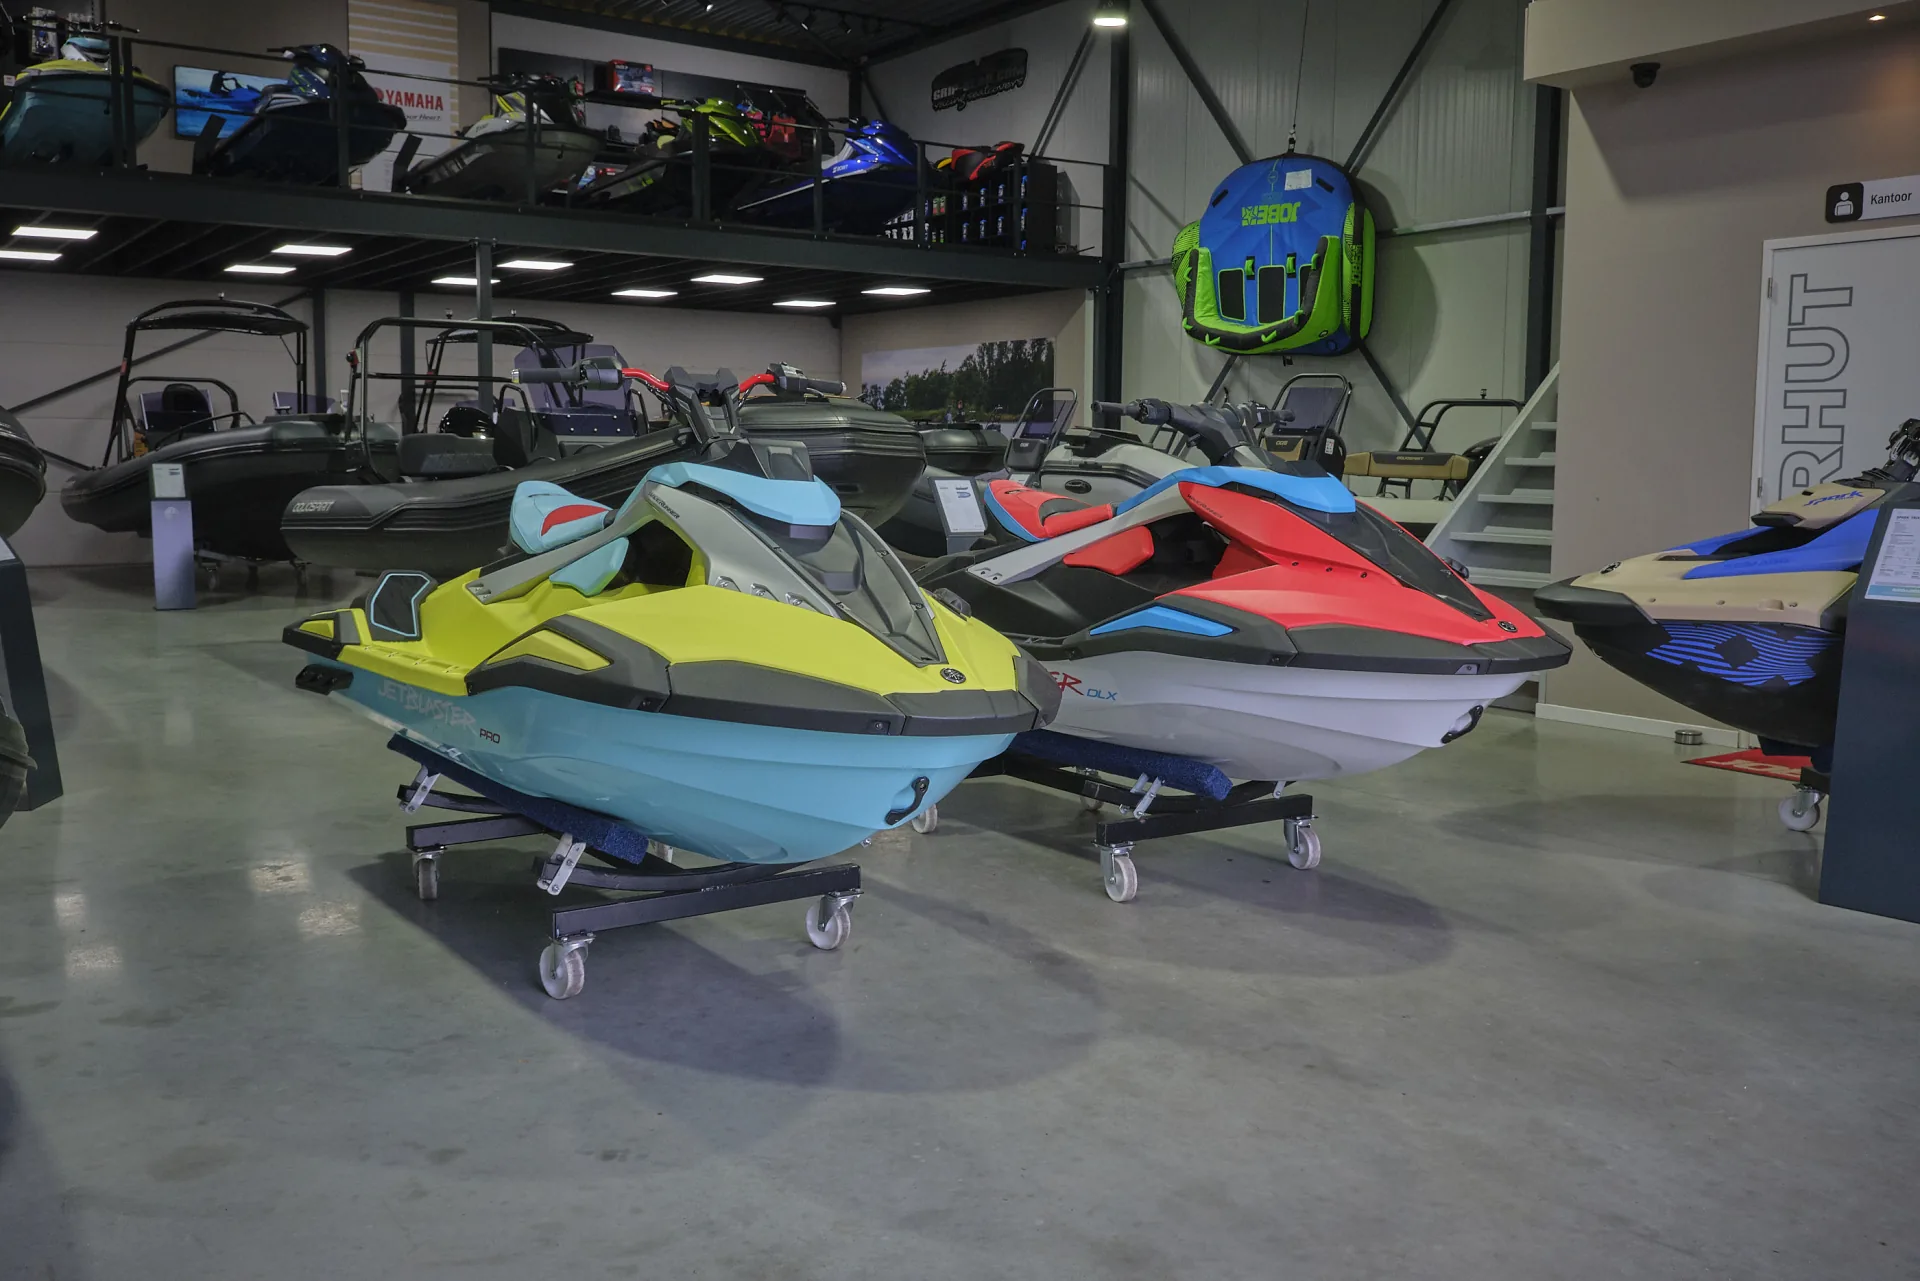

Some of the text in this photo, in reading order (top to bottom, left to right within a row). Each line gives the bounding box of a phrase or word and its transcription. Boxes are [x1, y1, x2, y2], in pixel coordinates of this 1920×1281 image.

[385, 89, 444, 111] YAMAHA
[1870, 192, 1913, 205] Kantoor
[1256, 201, 1302, 226] JOBE
[1086, 688, 1118, 701] DLX
[377, 679, 501, 744] JETBLASTER PRO
